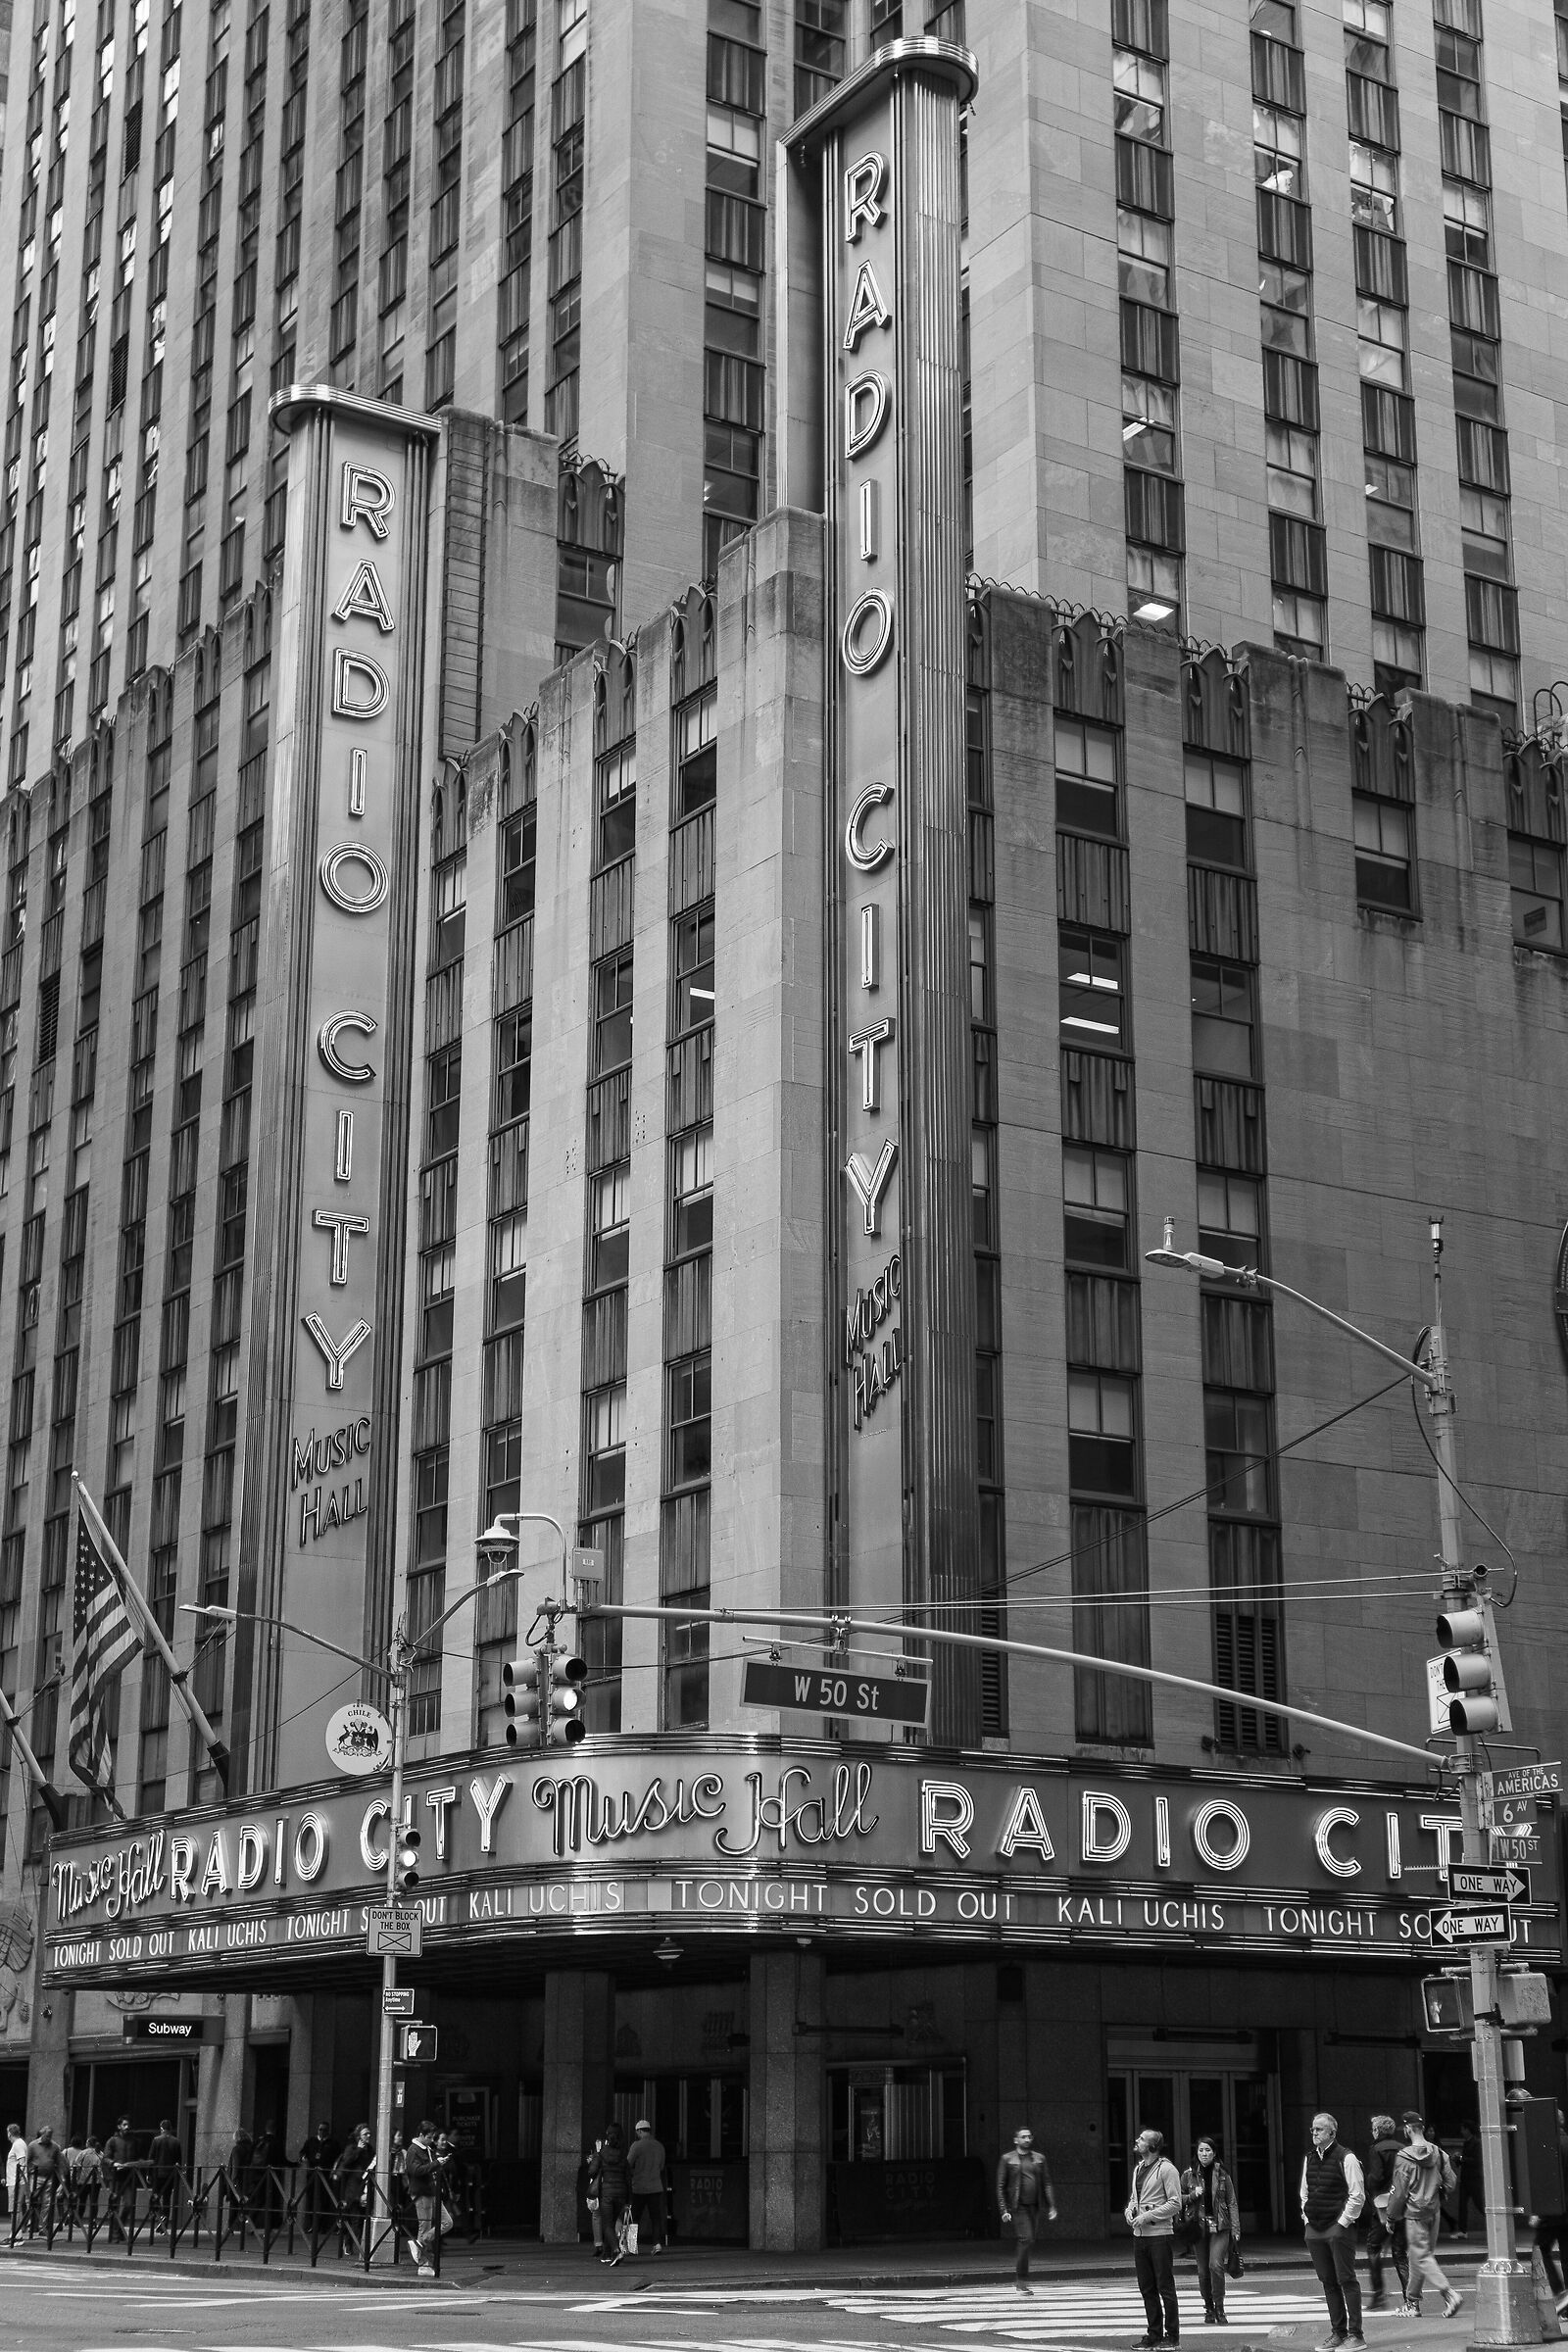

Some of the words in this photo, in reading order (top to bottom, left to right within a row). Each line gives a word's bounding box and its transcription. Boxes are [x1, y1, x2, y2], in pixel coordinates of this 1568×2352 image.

[842, 150, 894, 675] RADIO
[319, 461, 396, 913] RADIO
[844, 782, 901, 1236] CITY
[301, 1010, 378, 1391] CITY
[844, 1253, 903, 1369] MUSIC
[854, 1328, 904, 1430] HALL
[292, 1416, 372, 1492] MUSIC
[299, 1477, 368, 1548] HALL
[794, 1675, 810, 1702] W
[818, 1679, 848, 1707] 50
[857, 1684, 880, 1711] St
[347, 1709, 372, 1719] CHILE
[1497, 1773, 1559, 1795] AMERICAS
[1508, 1770, 1520, 1780] AVE
[1522, 1769, 1531, 1778] OF
[1532, 1767, 1544, 1776] THE
[532, 1771, 727, 1856] Music
[712, 1761, 880, 1856] Hall
[1503, 1803, 1513, 1823] 6
[1517, 1800, 1528, 1811] AV
[918, 1778, 1251, 1872] RADIO
[171, 1811, 329, 1902] RADIO
[1499, 1838, 1509, 1859] W
[1512, 1838, 1527, 1860] 50
[1528, 1839, 1538, 1850] ST
[52, 1854, 115, 1923] Music
[106, 1829, 169, 1919] Hall
[1460, 1876, 1484, 1891] ONE
[1493, 1878, 1517, 1893] WAY
[54, 1941, 102, 1968] TONIGHT
[109, 1936, 142, 1961] SOLD
[149, 1932, 174, 1955] OUT
[188, 1925, 219, 1951] KALI
[227, 1919, 267, 1946] UCHIS
[287, 1909, 350, 1939] TONIGHT
[469, 1888, 512, 1919] KALI
[529, 1882, 621, 1913] UCHIS
[675, 1881, 828, 1911] TONIGHT
[855, 1886, 937, 1917] SOLD
[957, 1891, 1015, 1921] OUT
[1058, 1896, 1122, 1926] KALI
[1143, 1899, 1225, 1931] UCHIS
[1263, 1906, 1377, 1936] TONIGHT
[372, 1911, 394, 1920] DON'T
[395, 1911, 418, 1921] BLOCK
[380, 1922, 394, 1931] THE
[396, 1922, 411, 1931] BOX
[1442, 1919, 1464, 1935] ONE
[1474, 1917, 1498, 1933] WAY
[148, 2022, 192, 2037] Subway
[690, 2178, 722, 2190] RADIO
[885, 2171, 935, 2185] RADIO
[885, 2185, 935, 2199] CITY
[690, 2191, 722, 2203] CITY
